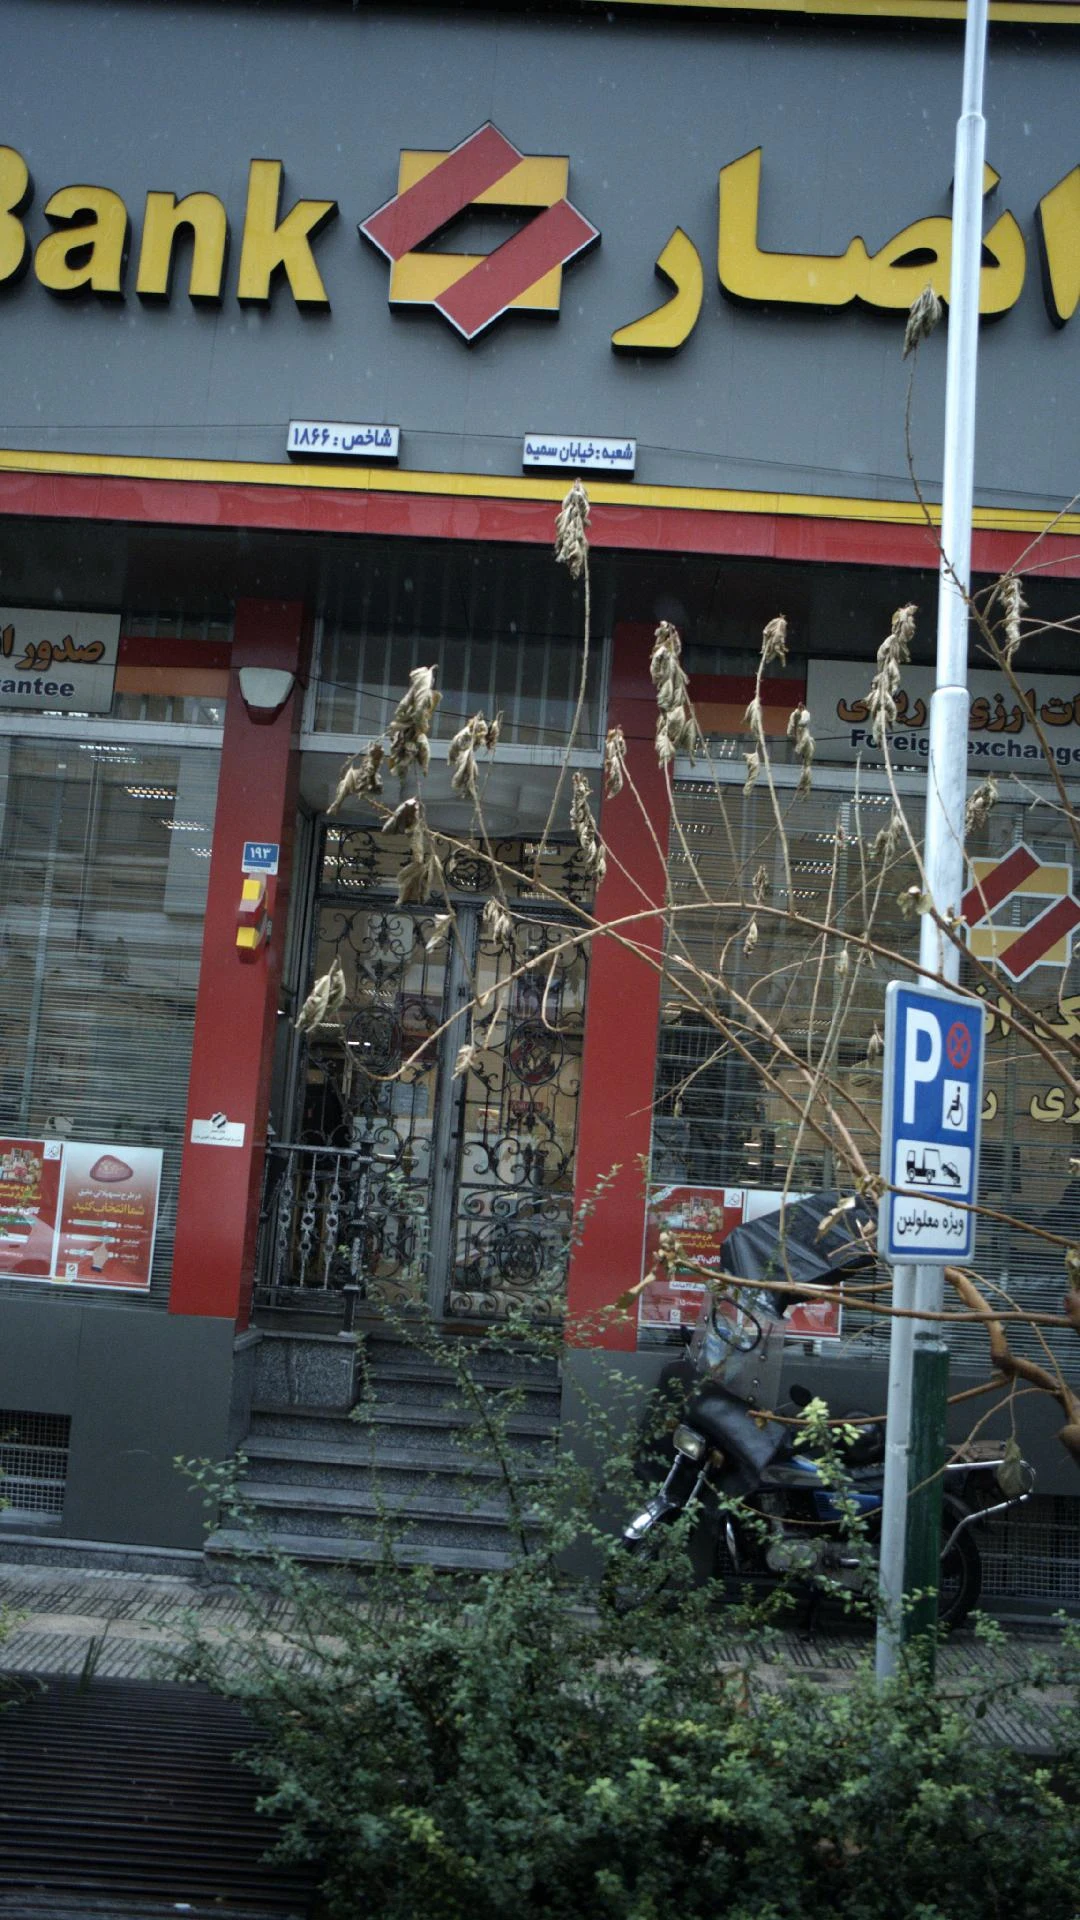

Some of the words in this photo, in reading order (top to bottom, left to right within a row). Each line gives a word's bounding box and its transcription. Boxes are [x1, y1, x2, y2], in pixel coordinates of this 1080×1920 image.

[294, 427, 330, 446] ۱۸۶۶
[525, 442, 558, 460] سمیه
[559, 442, 594, 463] خیابان
[0, 677, 75, 697] antee
[850, 728, 930, 757] Foeig
[250, 846, 272, 859] ۱۹۳
[902, 1006, 943, 1125] P
[897, 1208, 939, 1236] معلولین
[942, 1211, 964, 1237] ویژه
